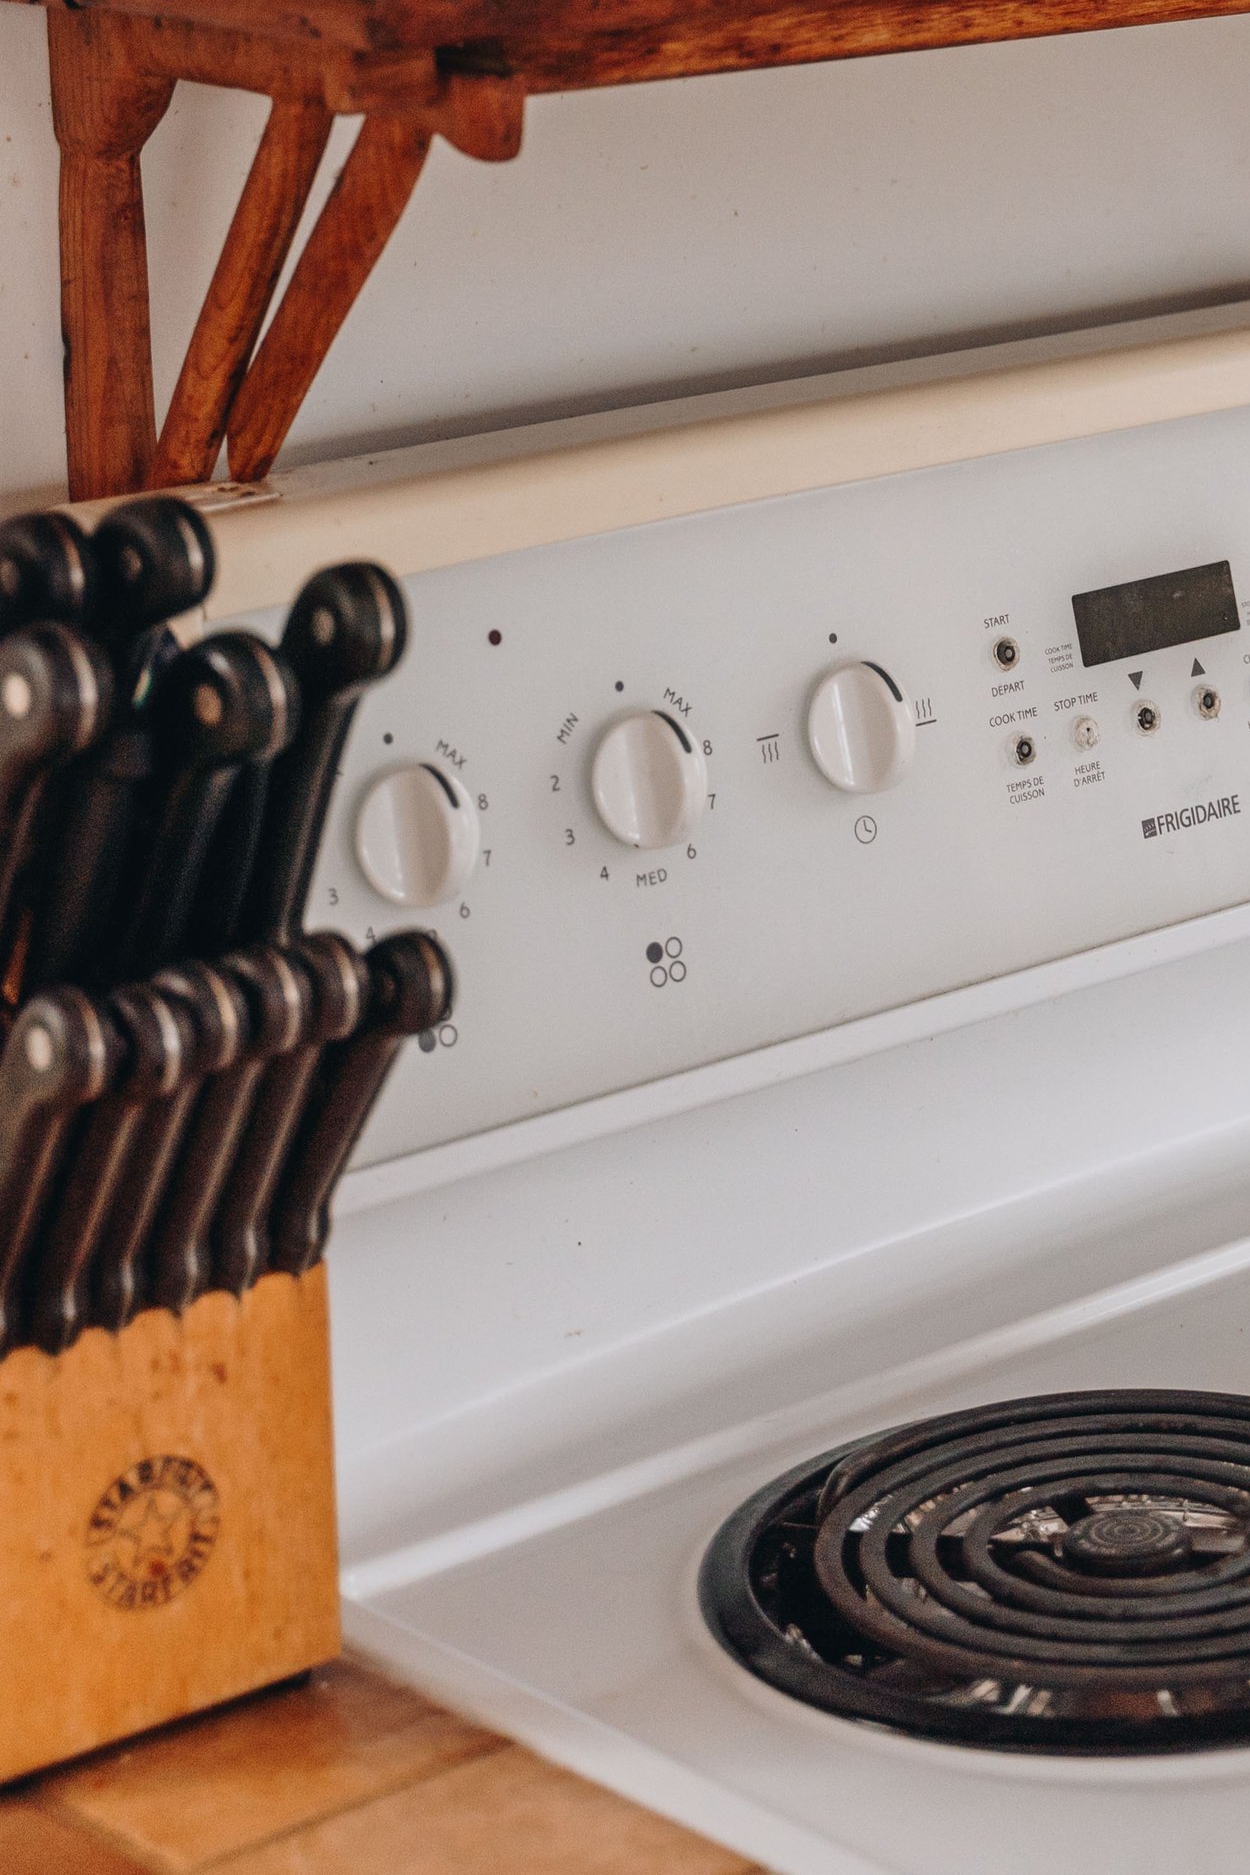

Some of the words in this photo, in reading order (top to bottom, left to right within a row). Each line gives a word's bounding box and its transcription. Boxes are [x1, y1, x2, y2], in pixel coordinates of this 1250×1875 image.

[983, 613, 1010, 629] START
[1044, 646, 1060, 656] COOK
[1061, 643, 1073, 651] TIME
[1048, 655, 1065, 664] TEMPS
[1050, 663, 1074, 674] CUISSON
[991, 680, 1025, 698] DEPART
[663, 687, 693, 718] MAX
[1053, 697, 1077, 712] STOP
[1077, 691, 1099, 706] TIME
[989, 712, 1016, 728] COOK
[1017, 706, 1038, 721] TIME
[556, 712, 580, 745] MIN
[435, 738, 468, 771] MAX
[702, 739, 713, 756] 8
[1074, 760, 1101, 775] HEURE
[550, 774, 561, 792] 2
[1006, 779, 1032, 794] TEMPS
[1032, 775, 1044, 787] DE
[478, 793, 489, 811] 8
[707, 793, 717, 810] 7
[1009, 787, 1046, 805] CUISSON
[1156, 794, 1241, 836] FRIGIDAIRE
[565, 828, 575, 845] 3
[482, 848, 493, 867] 7
[687, 843, 697, 860] 6
[599, 865, 610, 881] 4
[636, 868, 668, 887] MED
[327, 887, 340, 906] 3
[459, 901, 471, 920] 6
